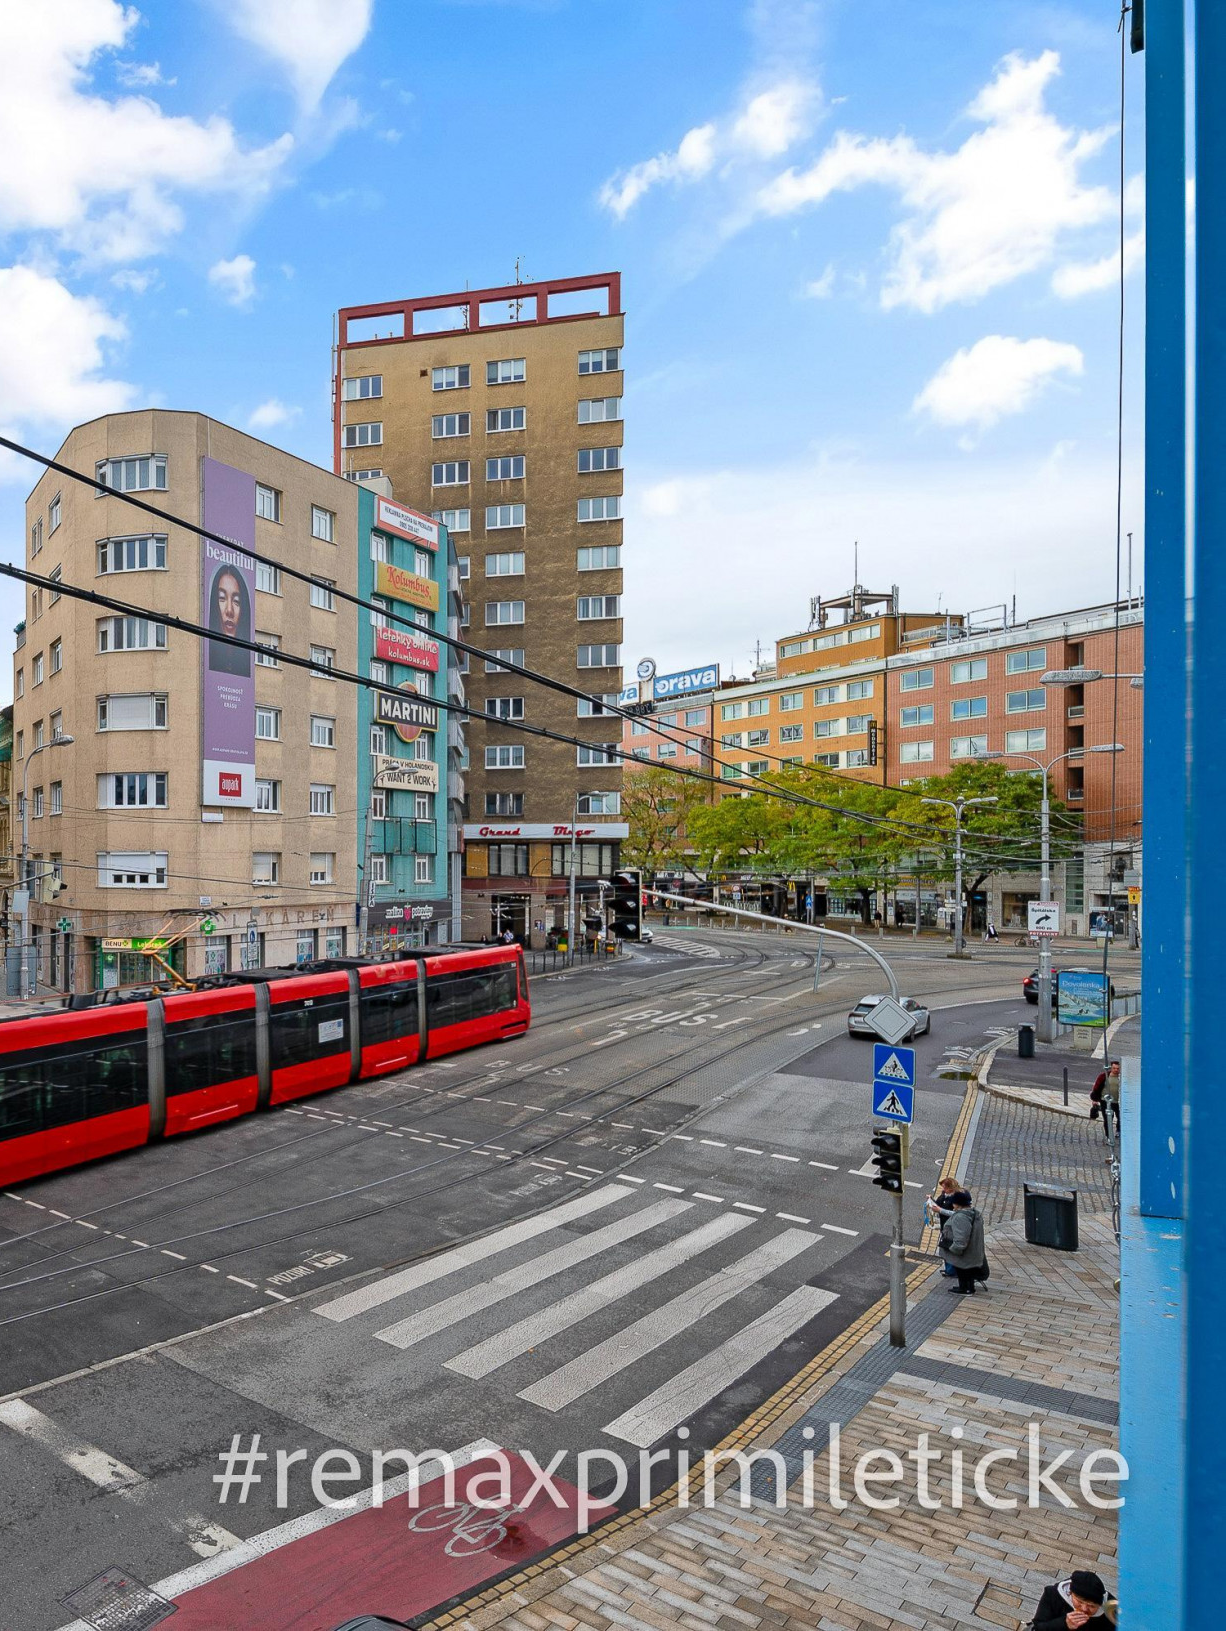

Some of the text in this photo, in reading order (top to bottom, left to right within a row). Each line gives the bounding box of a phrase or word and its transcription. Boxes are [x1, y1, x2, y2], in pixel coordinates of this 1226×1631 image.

[206, 540, 254, 571] beautiful
[387, 566, 430, 597] Kolumbus
[388, 646, 430, 667] kolumbus.sk
[655, 669, 716, 694] orava
[381, 697, 436, 725] MARTINI
[386, 772, 431, 786] WANT 2 WORK
[479, 827, 521, 837] Grand
[232, 905, 335, 928] LKÁREŇ
[620, 1009, 719, 1026] BUS
[484, 1060, 570, 1076] BUS
[266, 1265, 315, 1285] POZOR!
